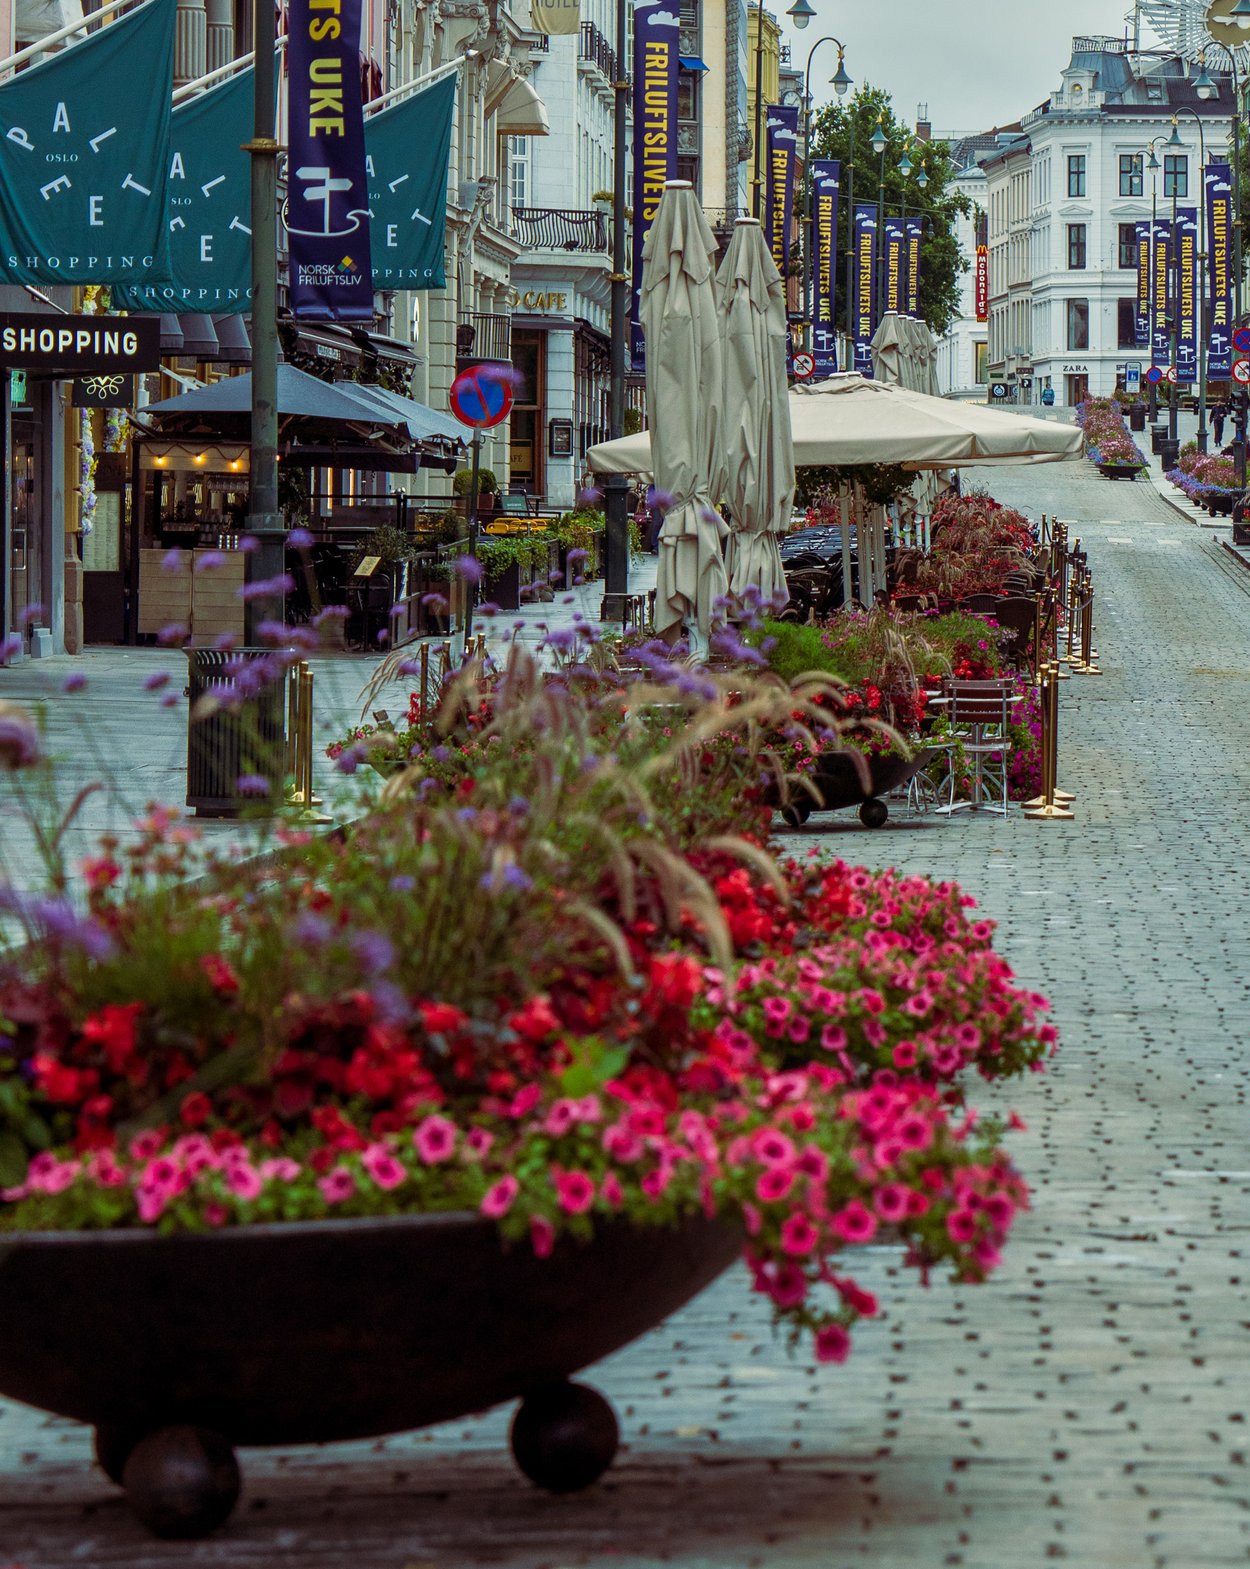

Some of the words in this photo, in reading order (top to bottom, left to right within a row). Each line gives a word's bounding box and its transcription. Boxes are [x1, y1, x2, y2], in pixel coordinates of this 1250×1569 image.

[308, 58, 345, 137] UKE
[46, 153, 79, 163] OSLO
[818, 195, 832, 294] FRILUFTSLIVETS
[1213, 199, 1226, 298] FRILUFTSLIVETS
[8, 256, 154, 268] SHOPPING
[298, 264, 335, 275] NORSK
[859, 233, 872, 314] FRILUFTSLIVETS
[909, 238, 918, 296] FRILUFTSLIVETS
[1140, 241, 1148, 298] FRILUFTSLIVETS
[298, 274, 362, 287] FRILUFTSLIV
[888, 242, 899, 309] FRILUFTSLIVETS
[1156, 243, 1166, 309] FRILUFTSLIVETS
[1181, 236, 1193, 317] FRILUFTSLIVETS
[819, 298, 831, 322] UKE
[909, 298, 917, 312] UKE
[1139, 299, 1147, 314] UKE
[1213, 301, 1226, 326] UKE
[859, 317, 870, 337] UKE
[1156, 311, 1166, 328] UKE
[1181, 319, 1193, 340] UKE
[2, 328, 138, 355] SHOPPING
